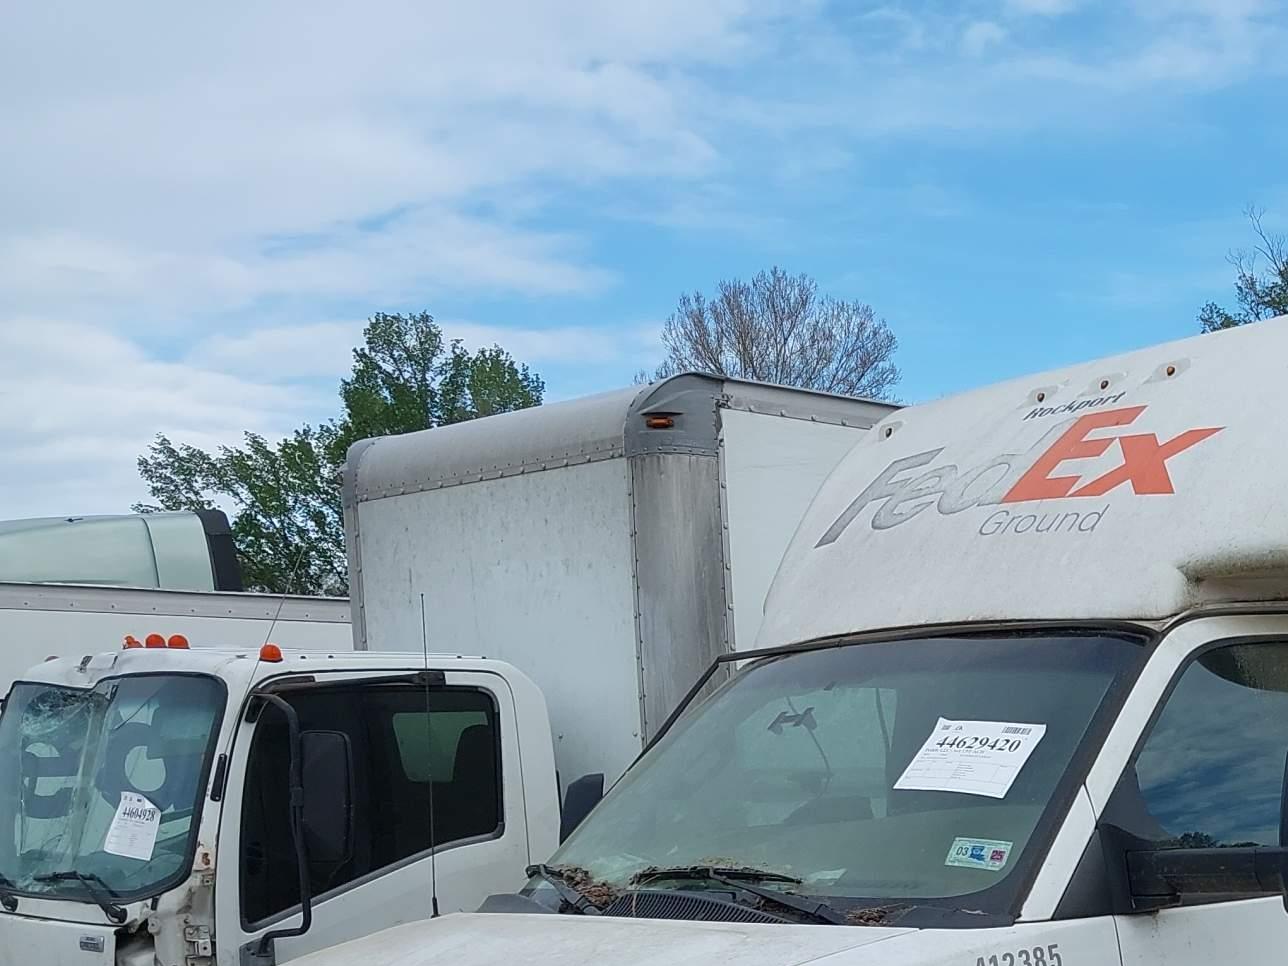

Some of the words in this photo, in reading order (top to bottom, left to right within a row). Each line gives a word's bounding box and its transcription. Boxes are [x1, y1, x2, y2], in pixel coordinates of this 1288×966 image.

[1023, 391, 1126, 421] Rockport
[814, 405, 1226, 548] FedEx
[979, 504, 1110, 536] Ground
[936, 736, 1022, 752] 44629420
[956, 846, 969, 856] 03
[991, 850, 1006, 860] 25
